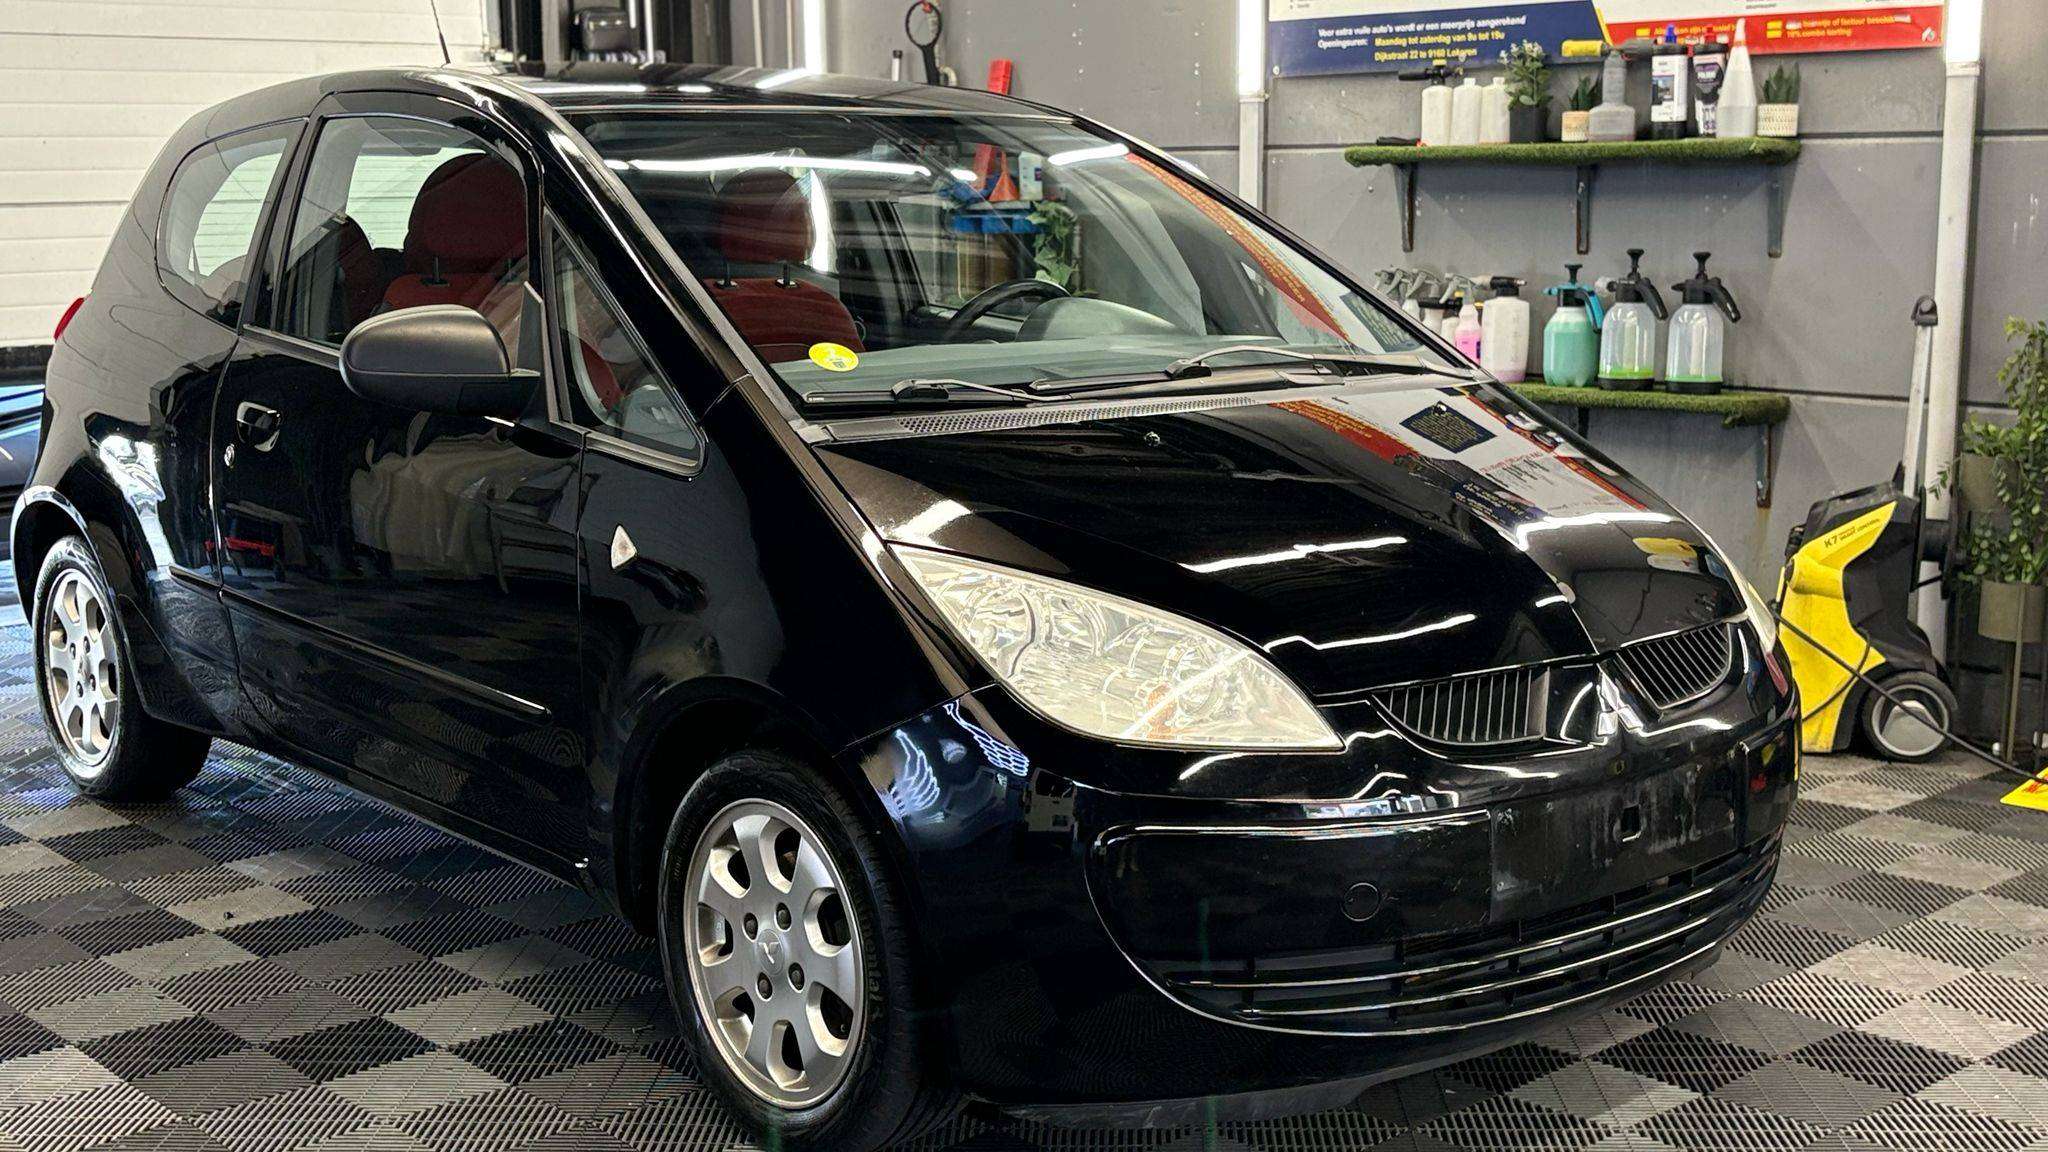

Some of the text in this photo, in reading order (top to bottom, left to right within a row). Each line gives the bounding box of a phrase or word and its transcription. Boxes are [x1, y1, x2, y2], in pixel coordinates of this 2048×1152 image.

[1318, 14, 1527, 37] Voor extra vuile auto's wordt er een meerprijs aangerekend
[1375, 37, 1407, 47] Maandag
[1408, 36, 1418, 44] tot
[1419, 34, 1451, 45] zaterdag
[1452, 34, 1466, 42] van
[1467, 32, 1477, 41] 9u
[1478, 32, 1489, 41] tot
[1375, 51, 1408, 62] Dijkstraat
[1409, 50, 1418, 59] 22
[1824, 535, 1837, 548] K7
